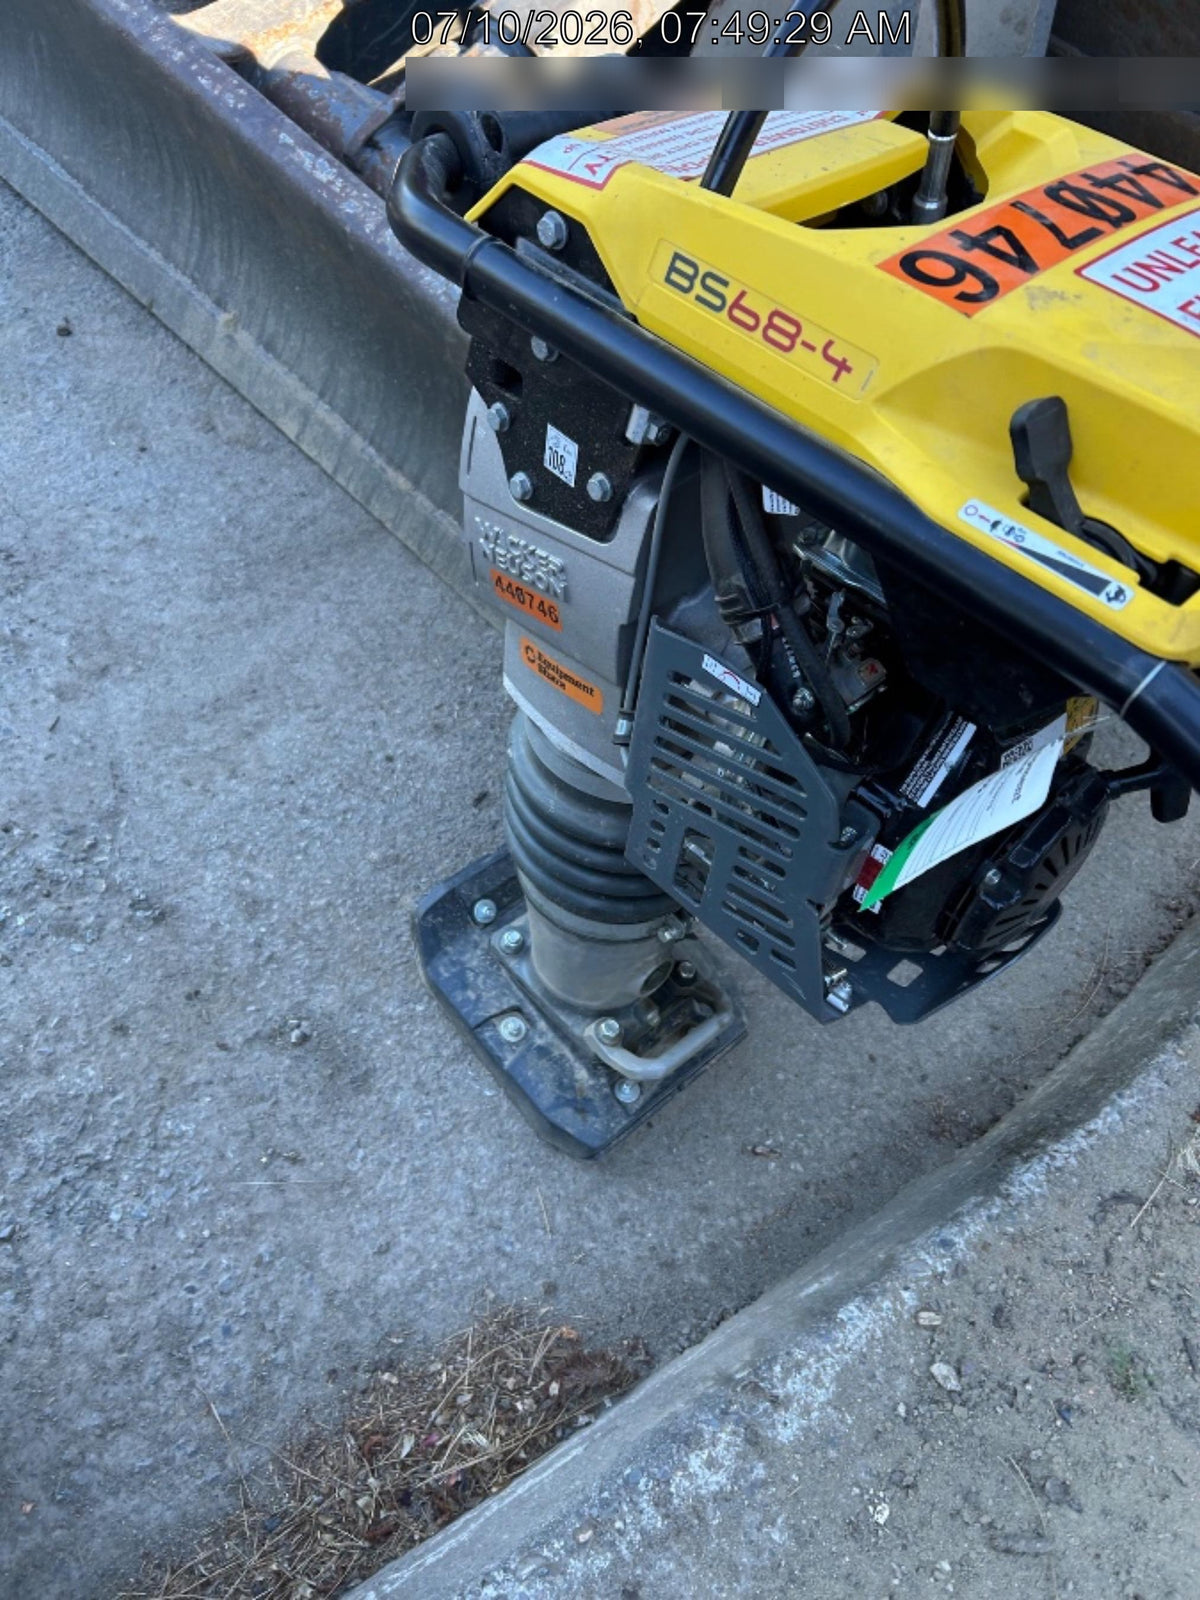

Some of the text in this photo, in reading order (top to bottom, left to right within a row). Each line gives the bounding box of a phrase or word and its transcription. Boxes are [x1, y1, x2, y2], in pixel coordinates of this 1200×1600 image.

[1110, 230, 1200, 293] UNLE
[664, 251, 853, 383] BS68-4
[479, 537, 569, 601] NEUSON
[536, 651, 596, 697] Equipment
